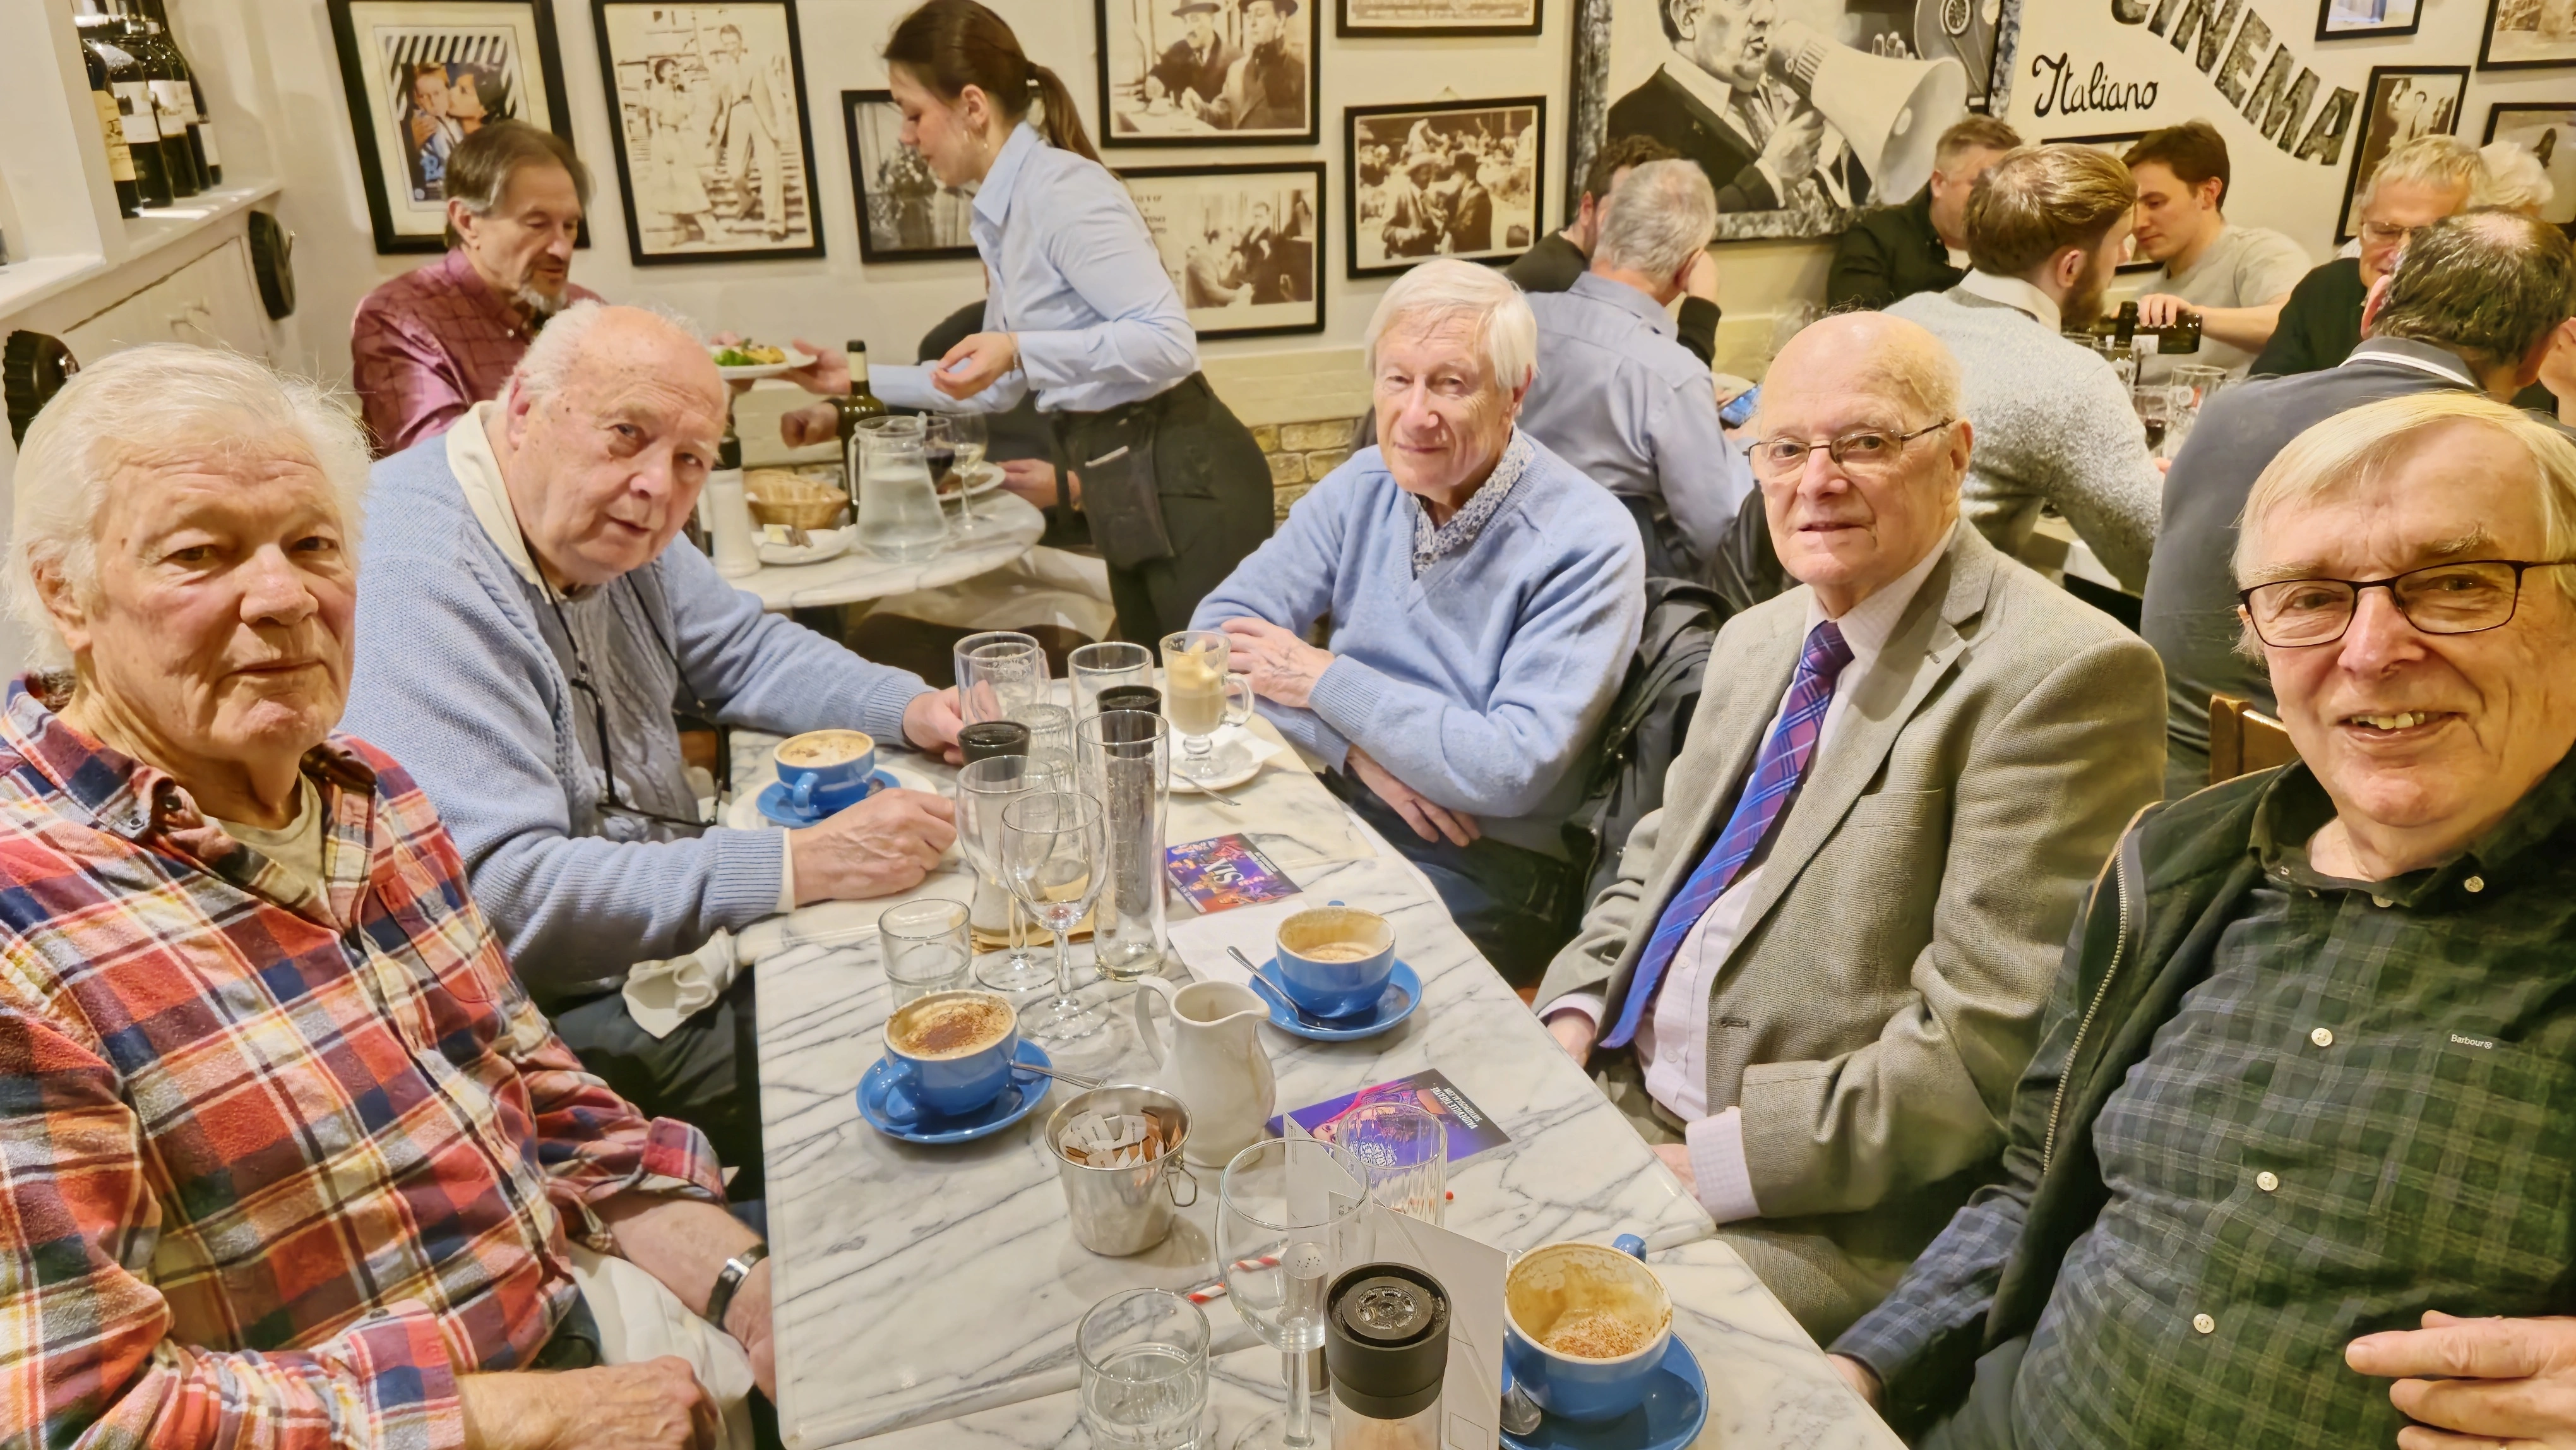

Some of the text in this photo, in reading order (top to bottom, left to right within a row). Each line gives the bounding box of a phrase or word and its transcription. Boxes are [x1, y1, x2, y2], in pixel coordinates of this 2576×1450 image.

[2032, 52, 2159, 118] Italiano
[1200, 857, 1244, 884] SIX
[2450, 1034, 2484, 1048] Barbour
[1429, 1086, 1478, 1129] VAUDEVILLE THEATRE
[1443, 1088, 1482, 1122] SIXTHEMUSICAL.COM
